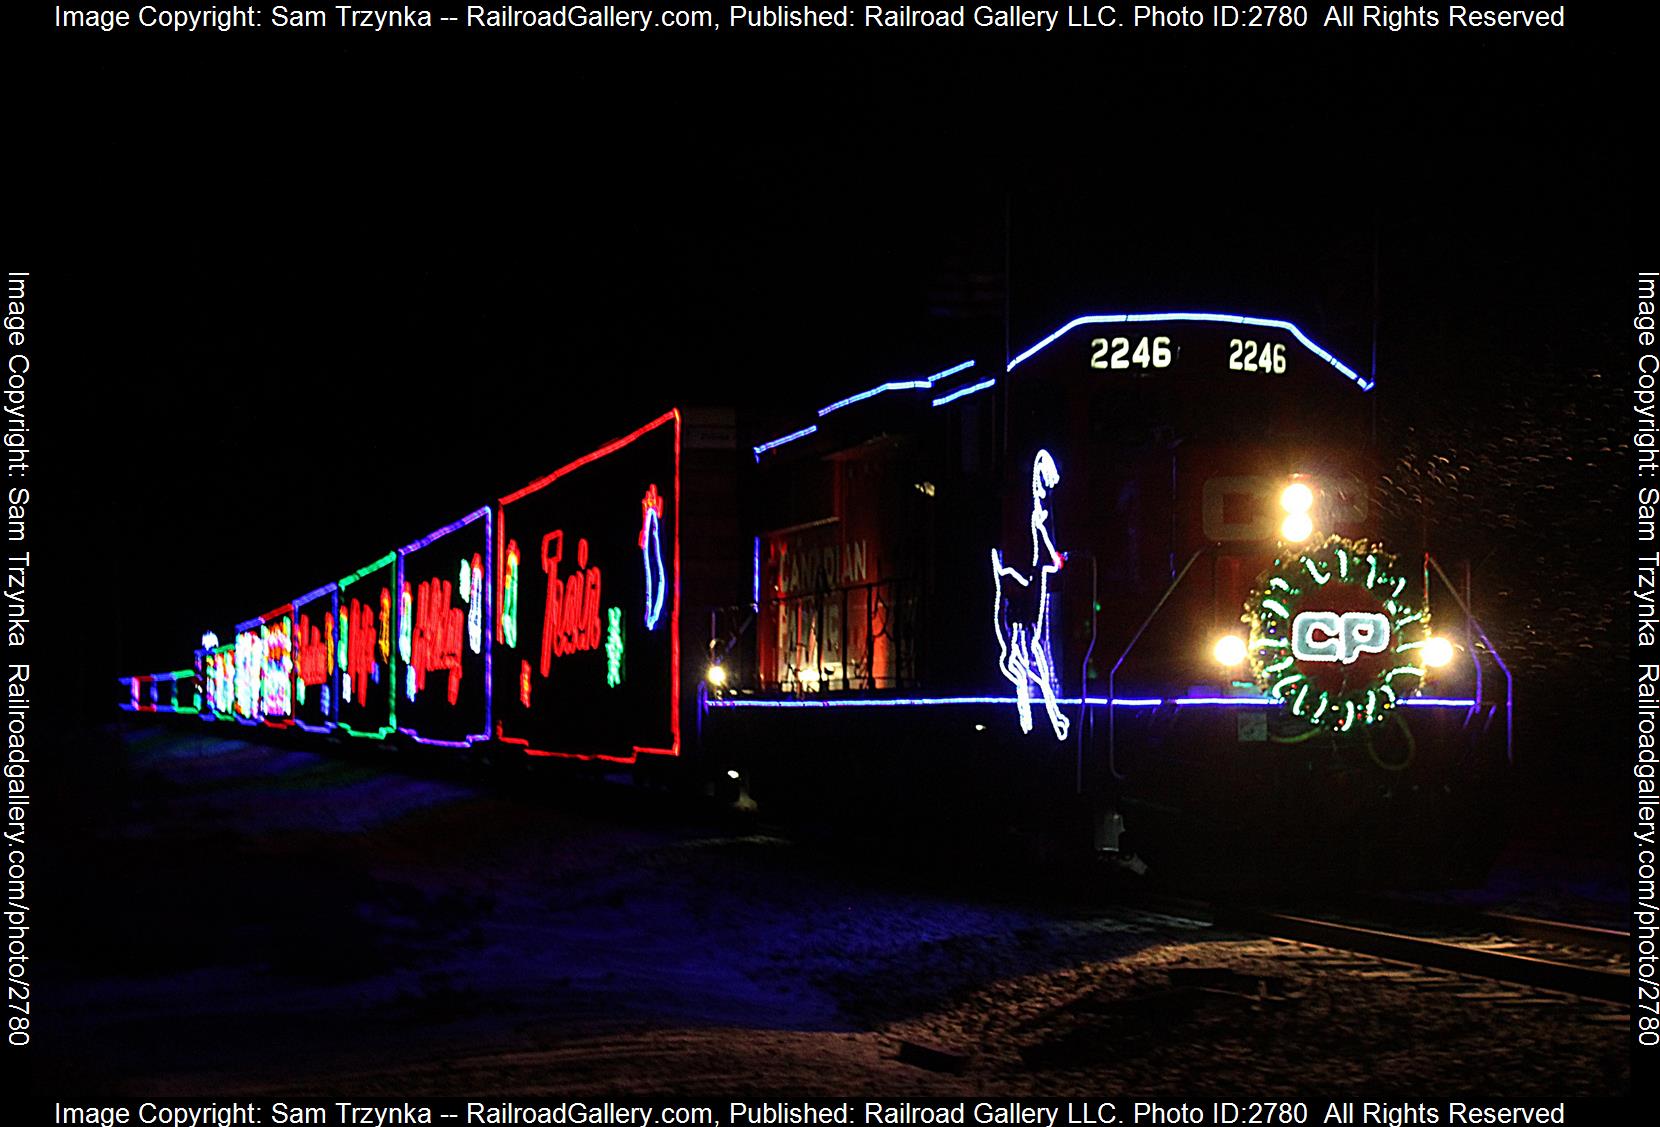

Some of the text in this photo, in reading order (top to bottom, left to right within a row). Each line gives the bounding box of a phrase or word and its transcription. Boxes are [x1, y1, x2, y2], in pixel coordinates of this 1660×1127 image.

[1091, 336, 1171, 369] 2246
[1229, 338, 1286, 374] 2246
[1292, 611, 1390, 664] CP
